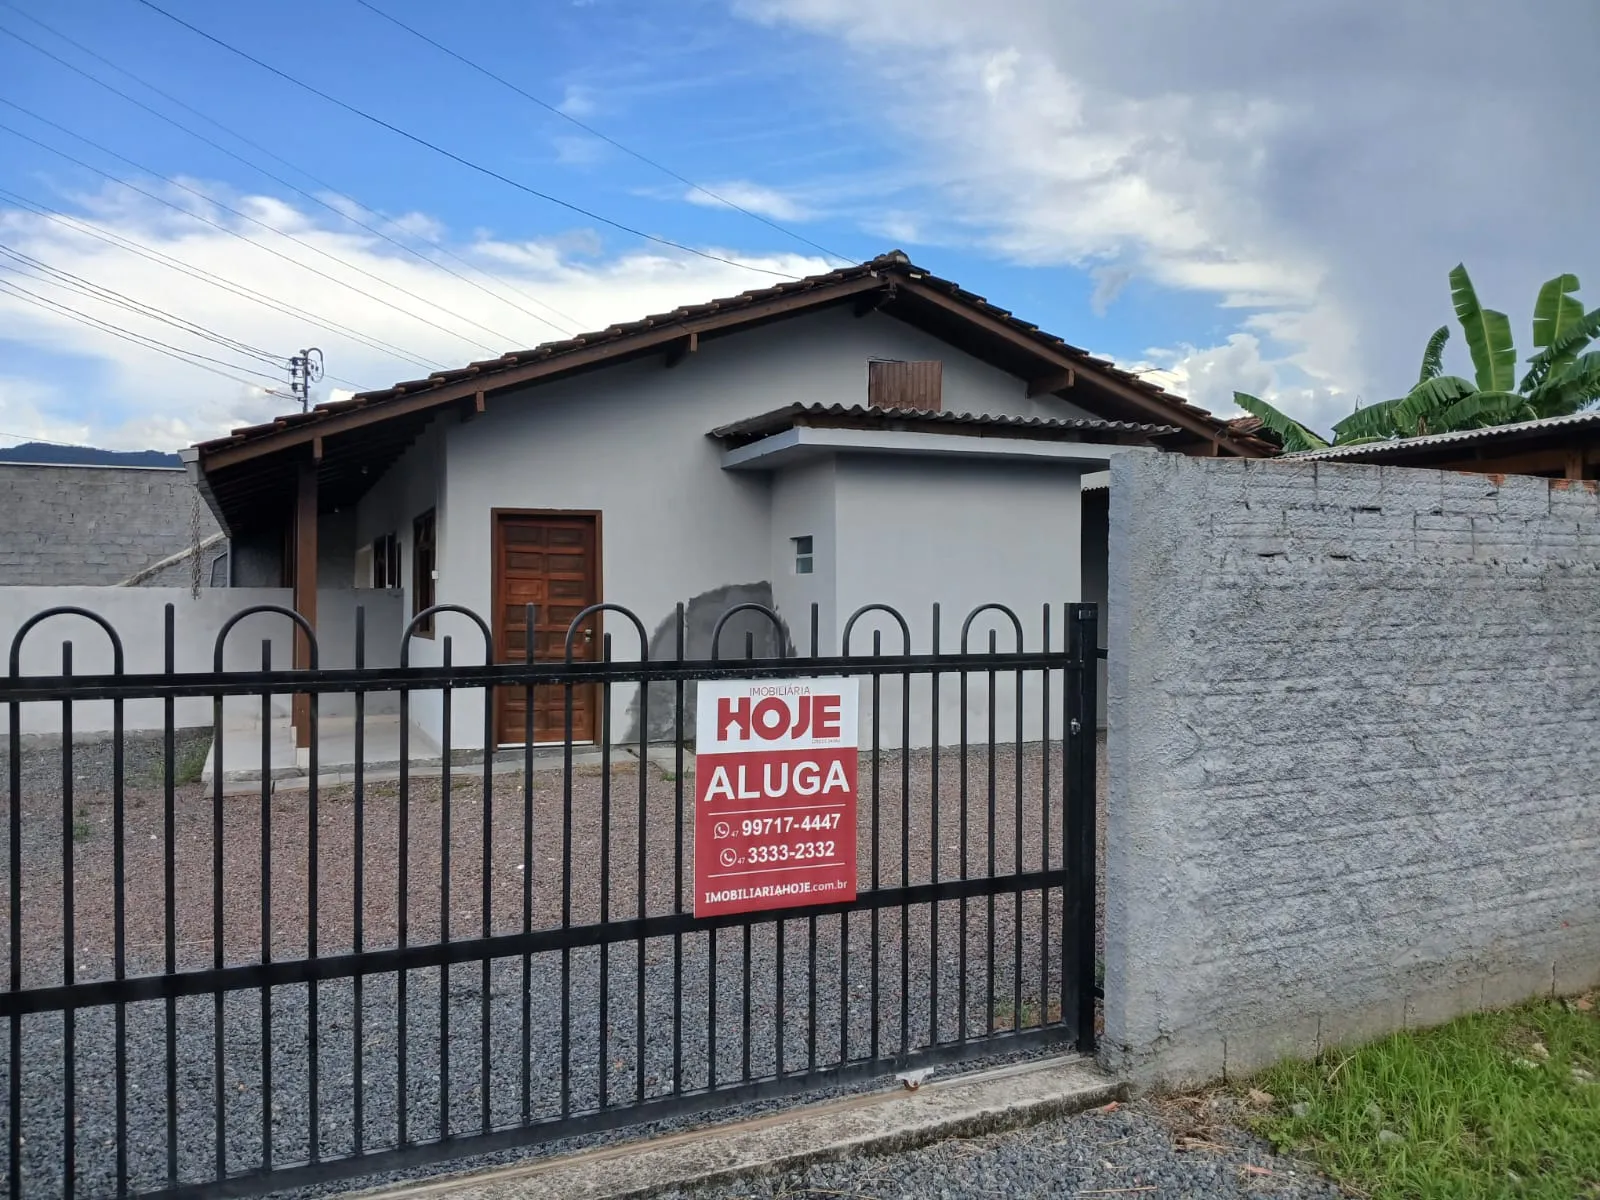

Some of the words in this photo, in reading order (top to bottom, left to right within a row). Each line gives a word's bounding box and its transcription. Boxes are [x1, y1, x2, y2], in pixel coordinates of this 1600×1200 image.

[750, 684, 810, 697] IMOBILIÁRIA
[717, 695, 841, 741] HOJE
[704, 760, 850, 802] ALUGA
[742, 813, 841, 836] 99717-4447
[737, 857, 745, 865] 47
[748, 840, 835, 864] 3333-2332
[705, 880, 847, 903] IMOBILIARIAHOJE.com.br
